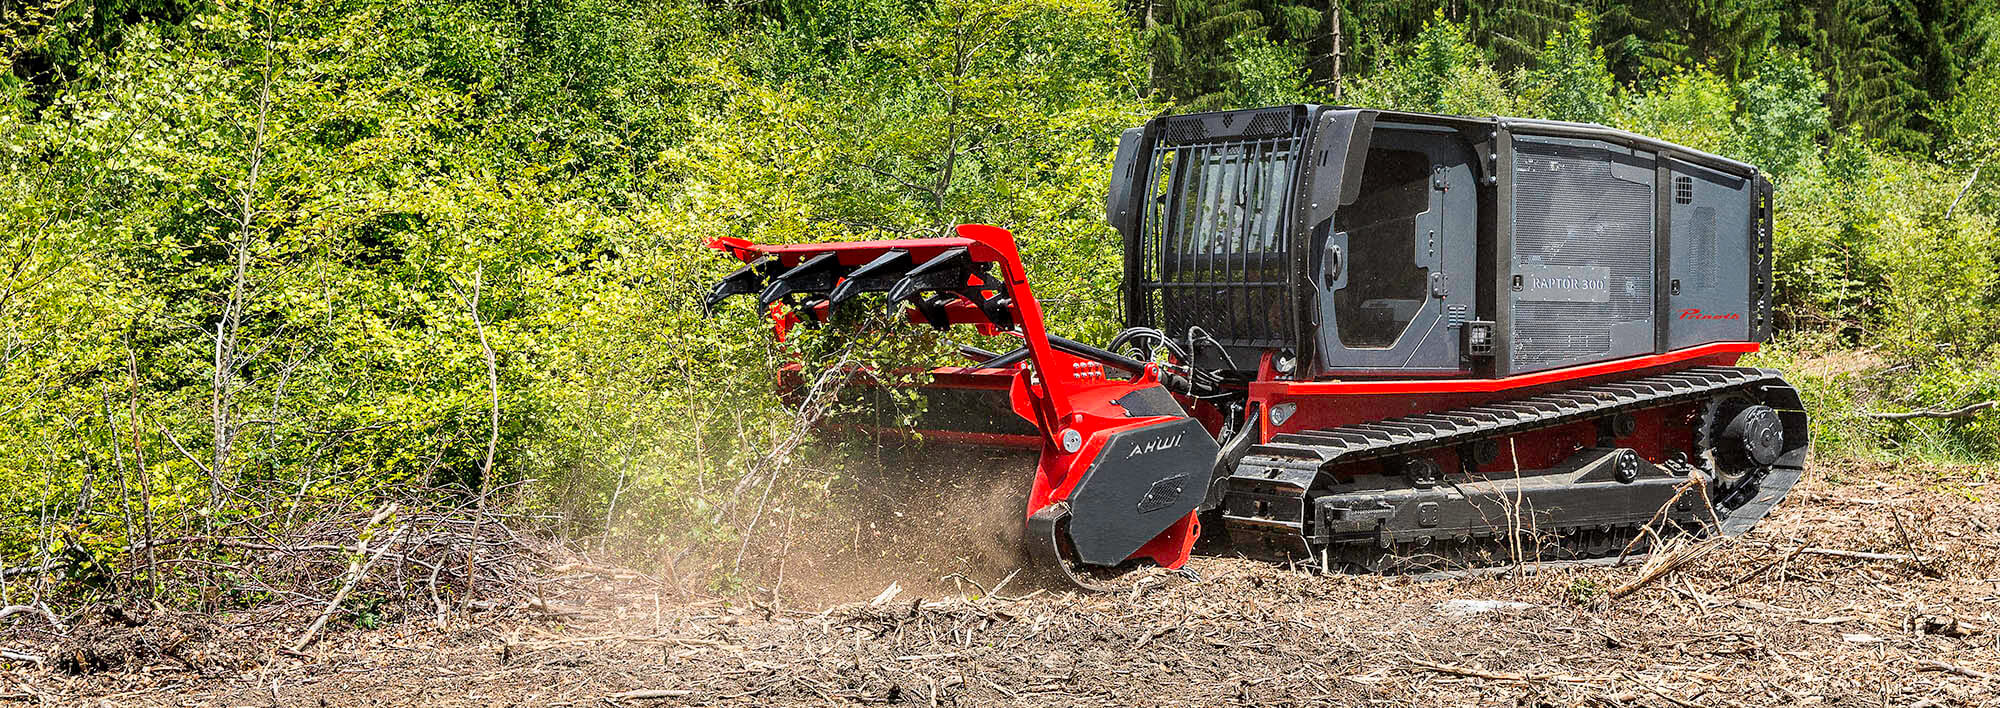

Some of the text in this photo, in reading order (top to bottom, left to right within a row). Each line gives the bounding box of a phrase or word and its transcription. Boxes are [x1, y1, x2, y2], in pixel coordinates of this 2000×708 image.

[1533, 278, 1605, 290] RAPTOR 300
[1129, 434, 1182, 457] AHWI
